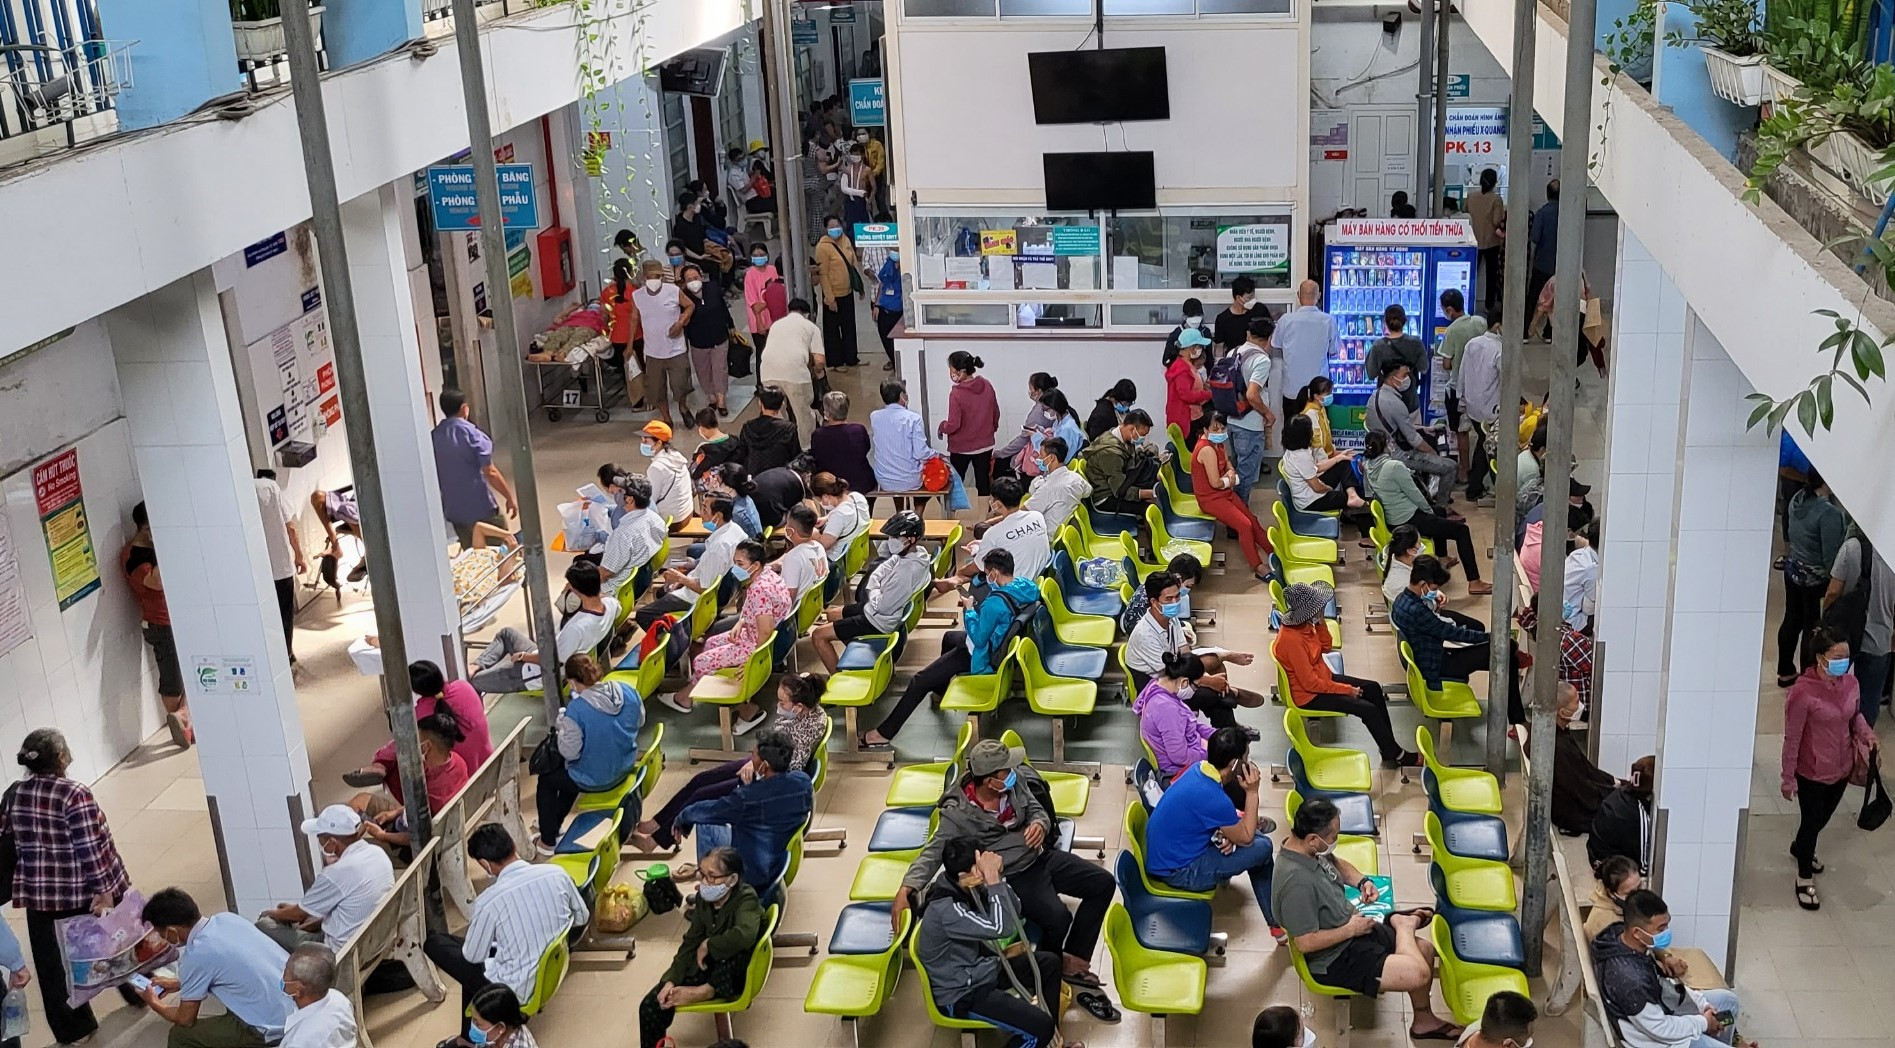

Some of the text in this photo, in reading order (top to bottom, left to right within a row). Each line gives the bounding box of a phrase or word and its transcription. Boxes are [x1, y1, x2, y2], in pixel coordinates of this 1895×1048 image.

[1462, 122, 1480, 135] PHIẾU
[1480, 126, 1506, 135] X-QUANG
[1445, 141, 1492, 154] PK.13
[438, 172, 472, 184] PHÒNG
[502, 171, 529, 183] BĂNG
[442, 191, 528, 206] PHÒNG PHẪU
[1341, 220, 1357, 236] MÁY
[1359, 220, 1373, 236] BÁN
[1376, 220, 1396, 236] HÀNG
[1398, 221, 1409, 236] CÓ
[1445, 222, 1464, 236] THỪA
[565, 393, 579, 404] 17
[36, 454, 76, 486] CẤM HÚT THUỐC
[56, 472, 76, 488] Smoking
[1005, 519, 1041, 540] CHAN
